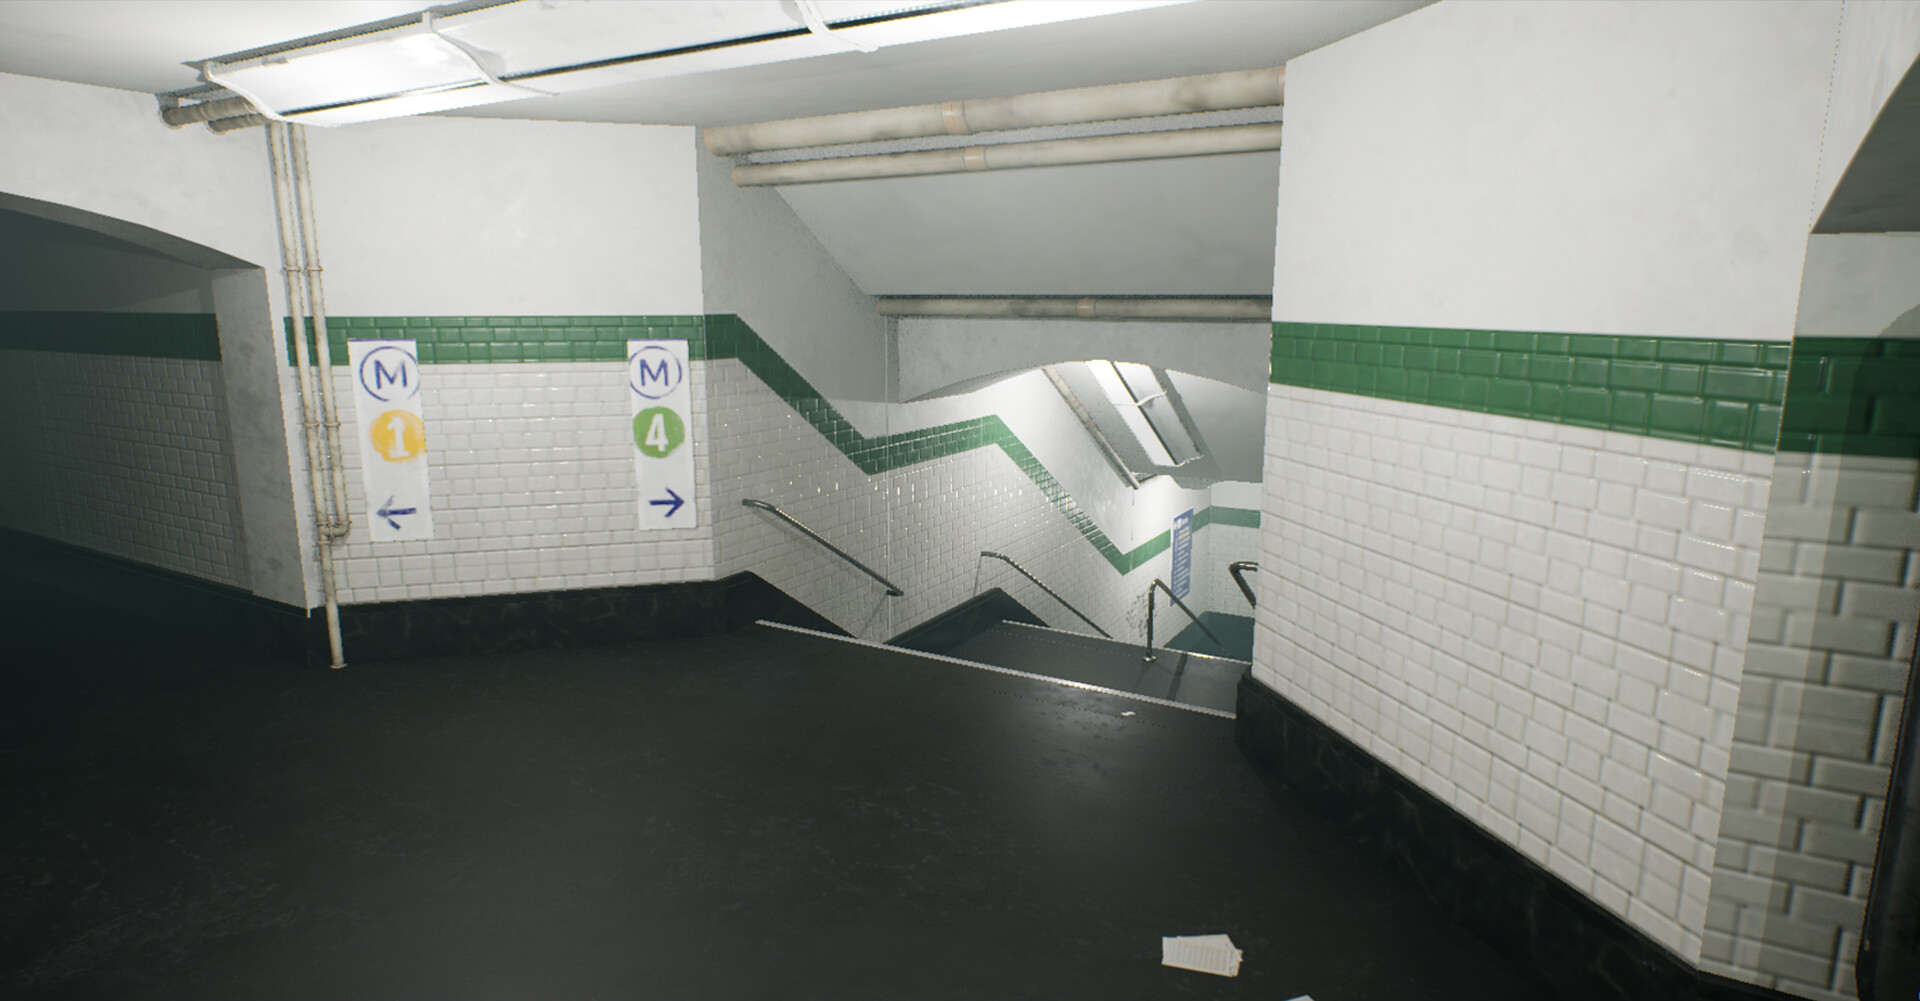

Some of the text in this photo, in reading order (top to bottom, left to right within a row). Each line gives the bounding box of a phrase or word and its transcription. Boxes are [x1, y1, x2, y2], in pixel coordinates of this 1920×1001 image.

[374, 359, 408, 390] M
[640, 358, 669, 387] M
[386, 416, 410, 458] 1
[645, 412, 669, 452] 4
